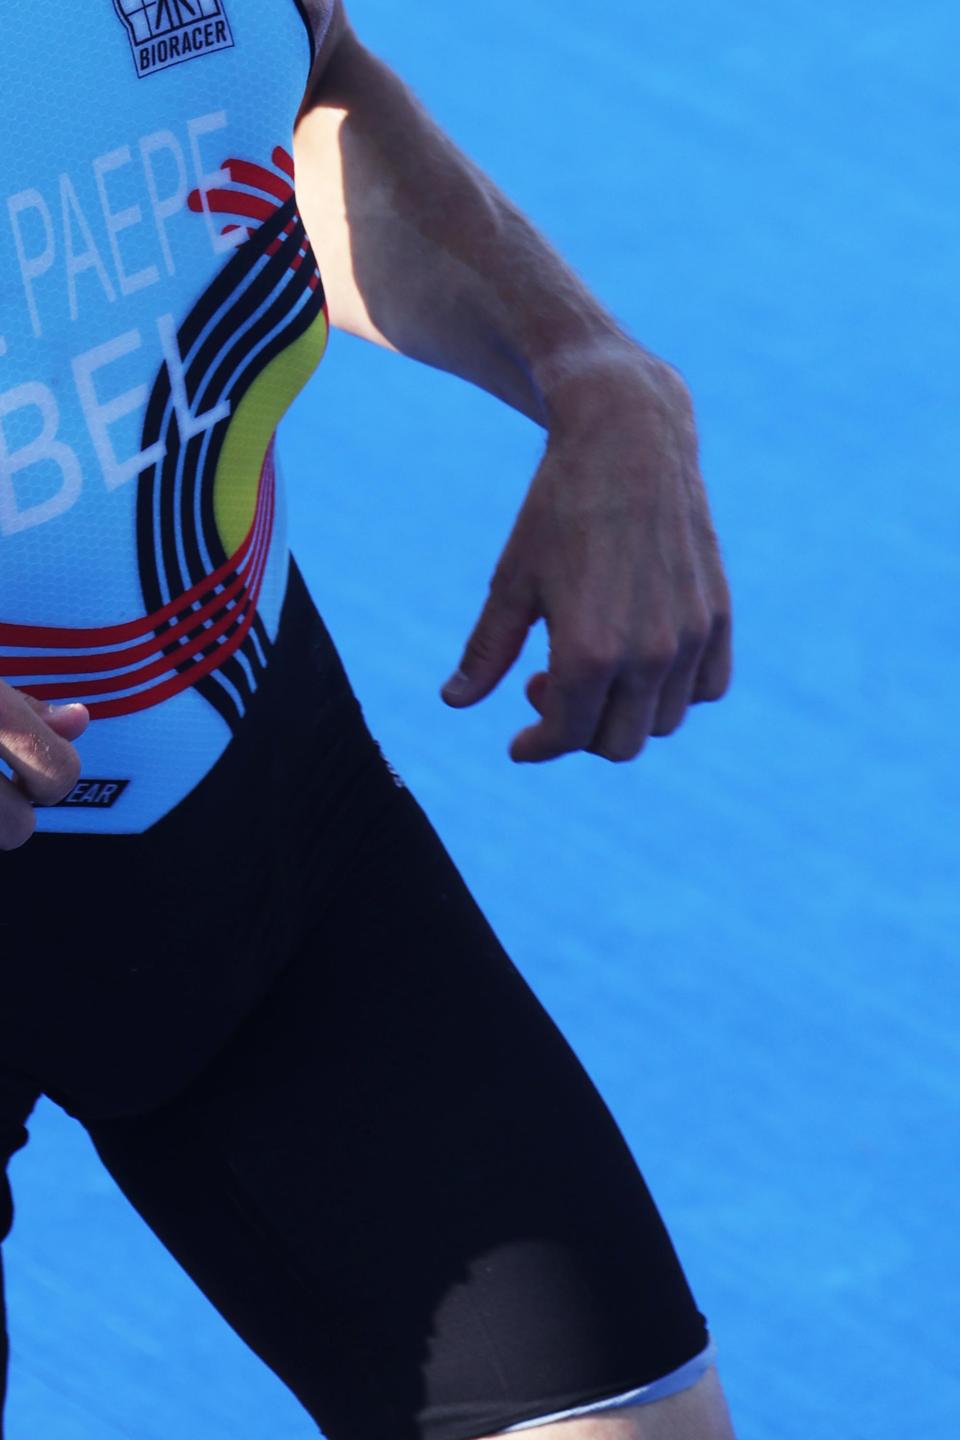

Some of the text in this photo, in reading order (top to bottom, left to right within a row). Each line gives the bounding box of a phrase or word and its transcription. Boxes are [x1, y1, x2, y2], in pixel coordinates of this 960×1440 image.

[139, 20, 227, 70] BIORACER
[6, 109, 248, 338] PAEPE
[65, 783, 119, 803] EAR
